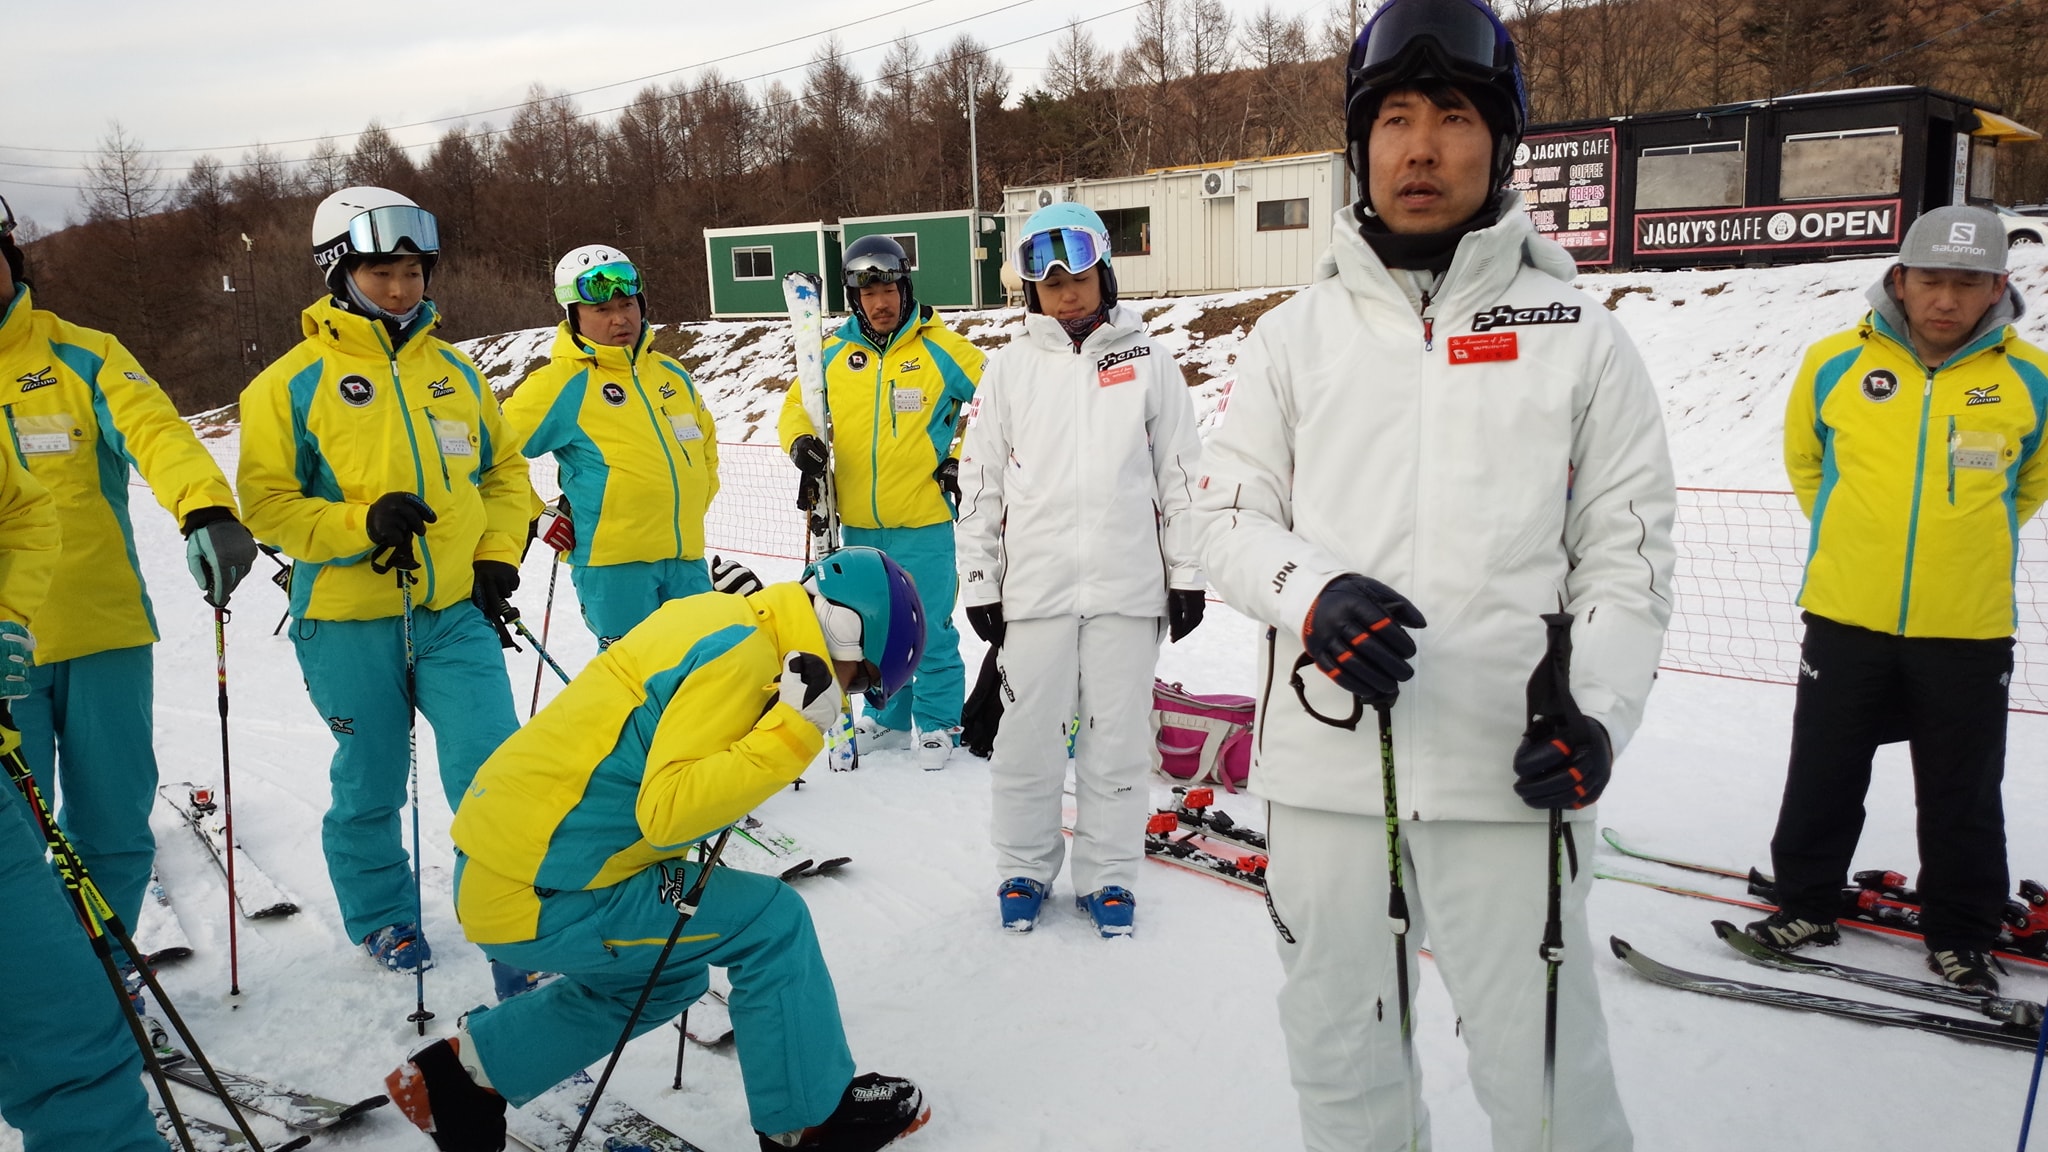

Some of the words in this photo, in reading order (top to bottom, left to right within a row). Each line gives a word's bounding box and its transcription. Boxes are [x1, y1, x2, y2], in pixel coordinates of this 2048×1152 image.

[1532, 142, 1579, 160] JACKY'S
[1583, 139, 1610, 156] CAFE
[1513, 168, 1532, 182] OUP
[1569, 163, 1604, 179] COFFEE
[1569, 185, 1605, 201] CREPES
[1643, 219, 1716, 245] JACKY'S
[1720, 217, 1762, 242] CAFE
[1800, 209, 1890, 239] OPEN
[313, 241, 349, 266] GIRO
[1474, 303, 1577, 331] phenix
[1098, 346, 1149, 372] phenix
[967, 569, 984, 583] JPN
[1271, 561, 1298, 594] JPN
[48, 841, 79, 890] LEKI
[854, 1086, 892, 1098] maski
